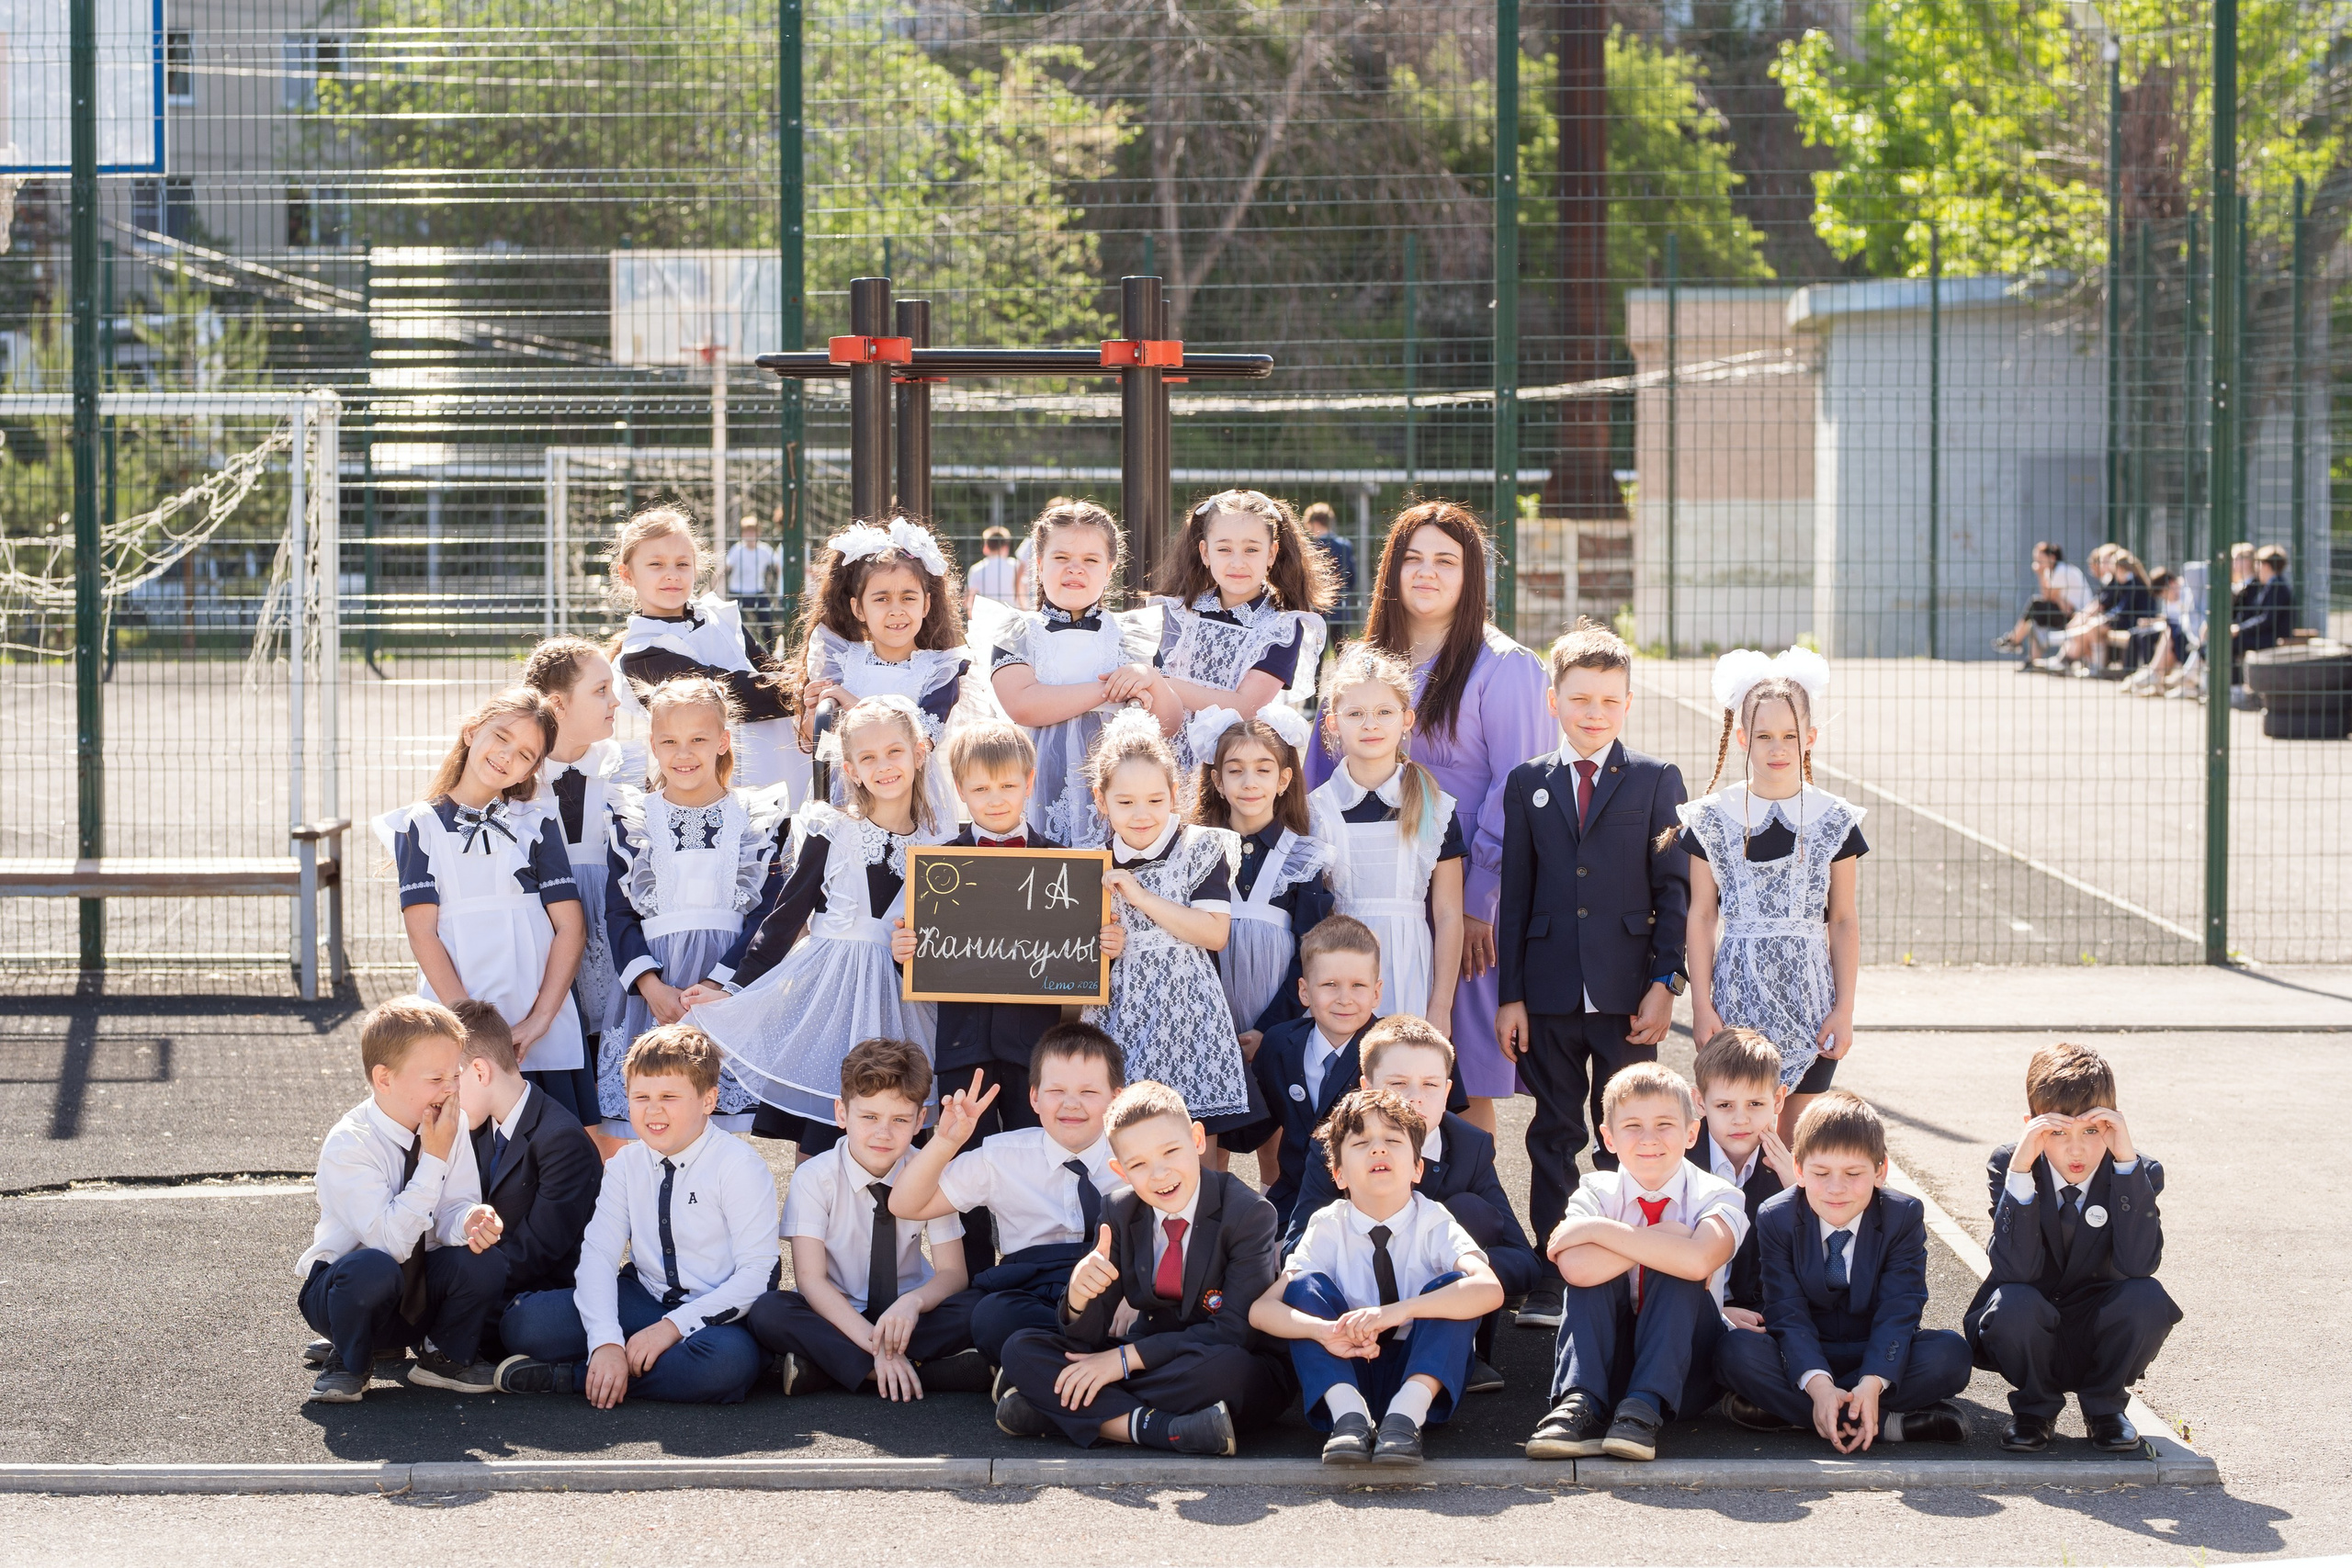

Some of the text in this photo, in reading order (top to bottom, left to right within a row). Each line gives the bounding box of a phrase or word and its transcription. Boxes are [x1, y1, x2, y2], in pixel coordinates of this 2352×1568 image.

[916, 924, 1099, 979] Каникулы
[1077, 980, 1099, 990] 2026
[688, 1191, 698, 1204] A
